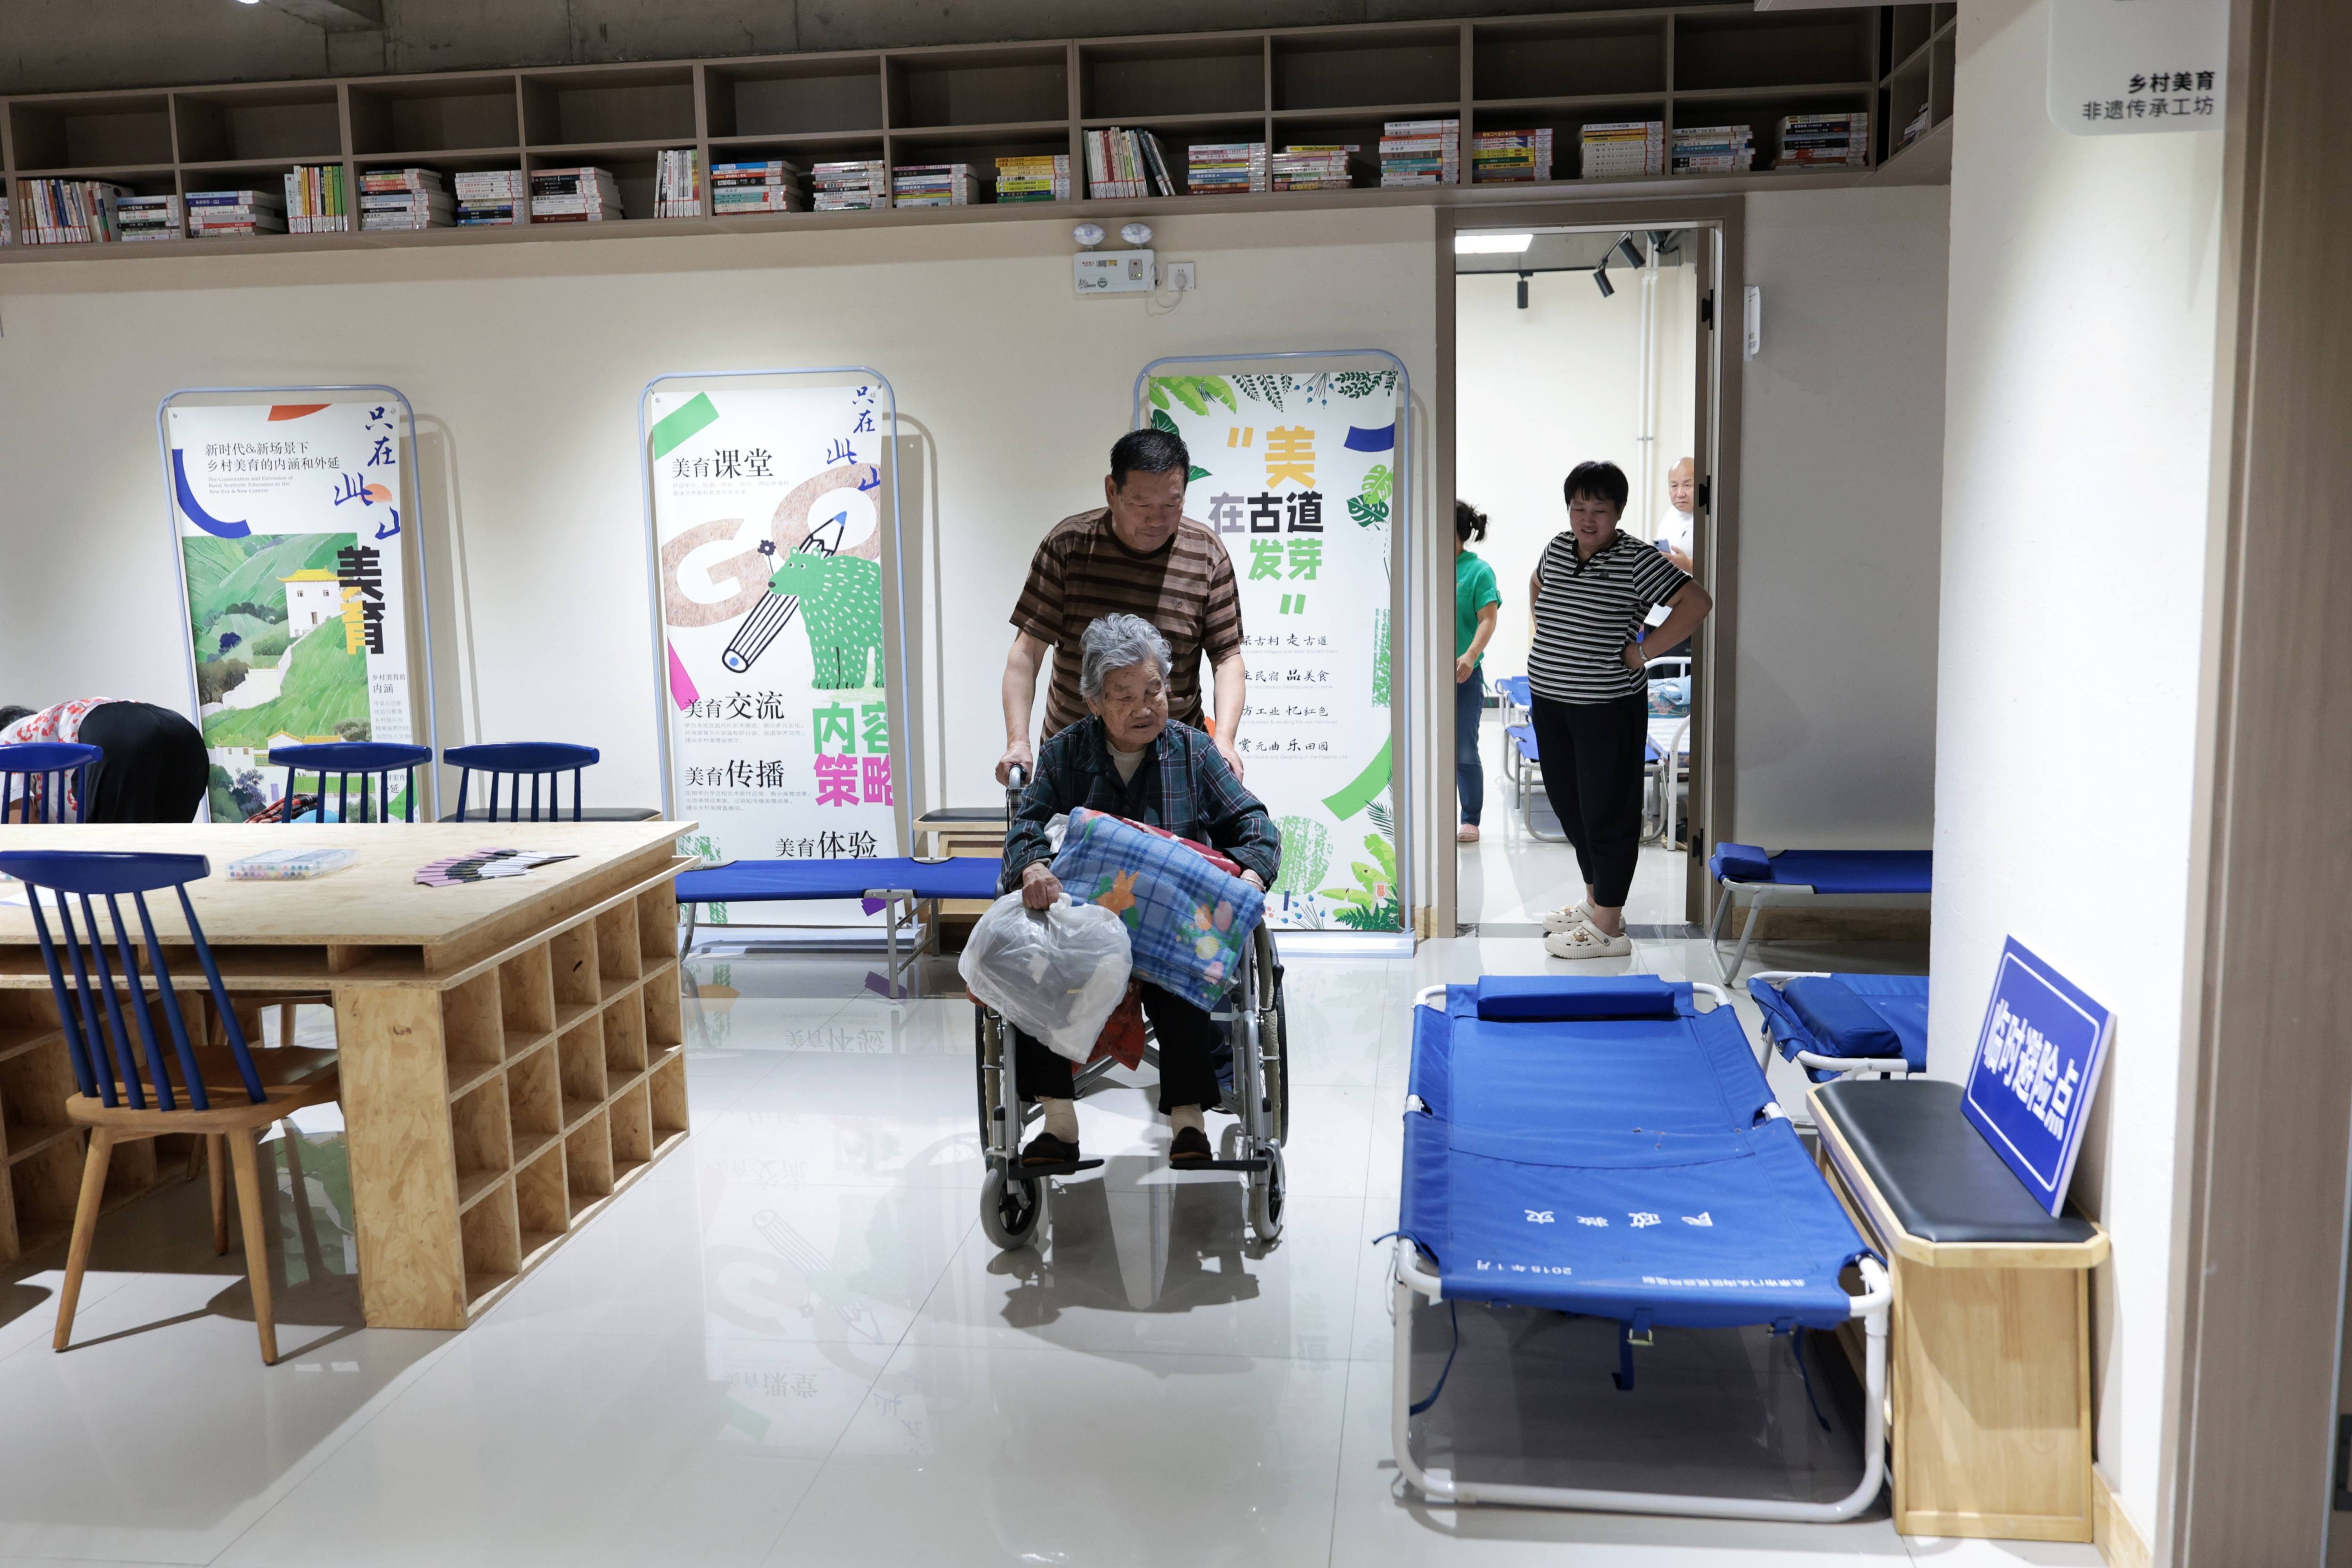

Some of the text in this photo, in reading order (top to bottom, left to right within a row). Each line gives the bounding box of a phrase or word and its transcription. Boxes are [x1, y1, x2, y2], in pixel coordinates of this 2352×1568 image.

[2128, 70, 2215, 94] 乡村美育
[2082, 96, 2214, 121] 非遗传承工坊
[205, 441, 309, 456] 新时代&新场景下
[207, 457, 340, 472] 乡村美育的内涵和外延
[672, 448, 774, 478] 美育课堂
[1208, 491, 1323, 534] 在古道
[1248, 538, 1322, 581] 发芽
[337, 545, 386, 655] 美育
[1286, 633, 1328, 647] 走古道
[1287, 669, 1330, 682] 品美食
[373, 684, 393, 693] 内涵
[684, 691, 784, 720] 美育交流
[1286, 705, 1328, 717] 忆红色
[812, 702, 889, 753] 内容
[1239, 738, 1328, 752] 赏元曲 乐田园
[684, 760, 784, 788] 美育传播
[775, 830, 878, 859] 美育体验
[1983, 998, 2080, 1141] 临时避险点
[1524, 1209, 1713, 1228] 民政救灾
